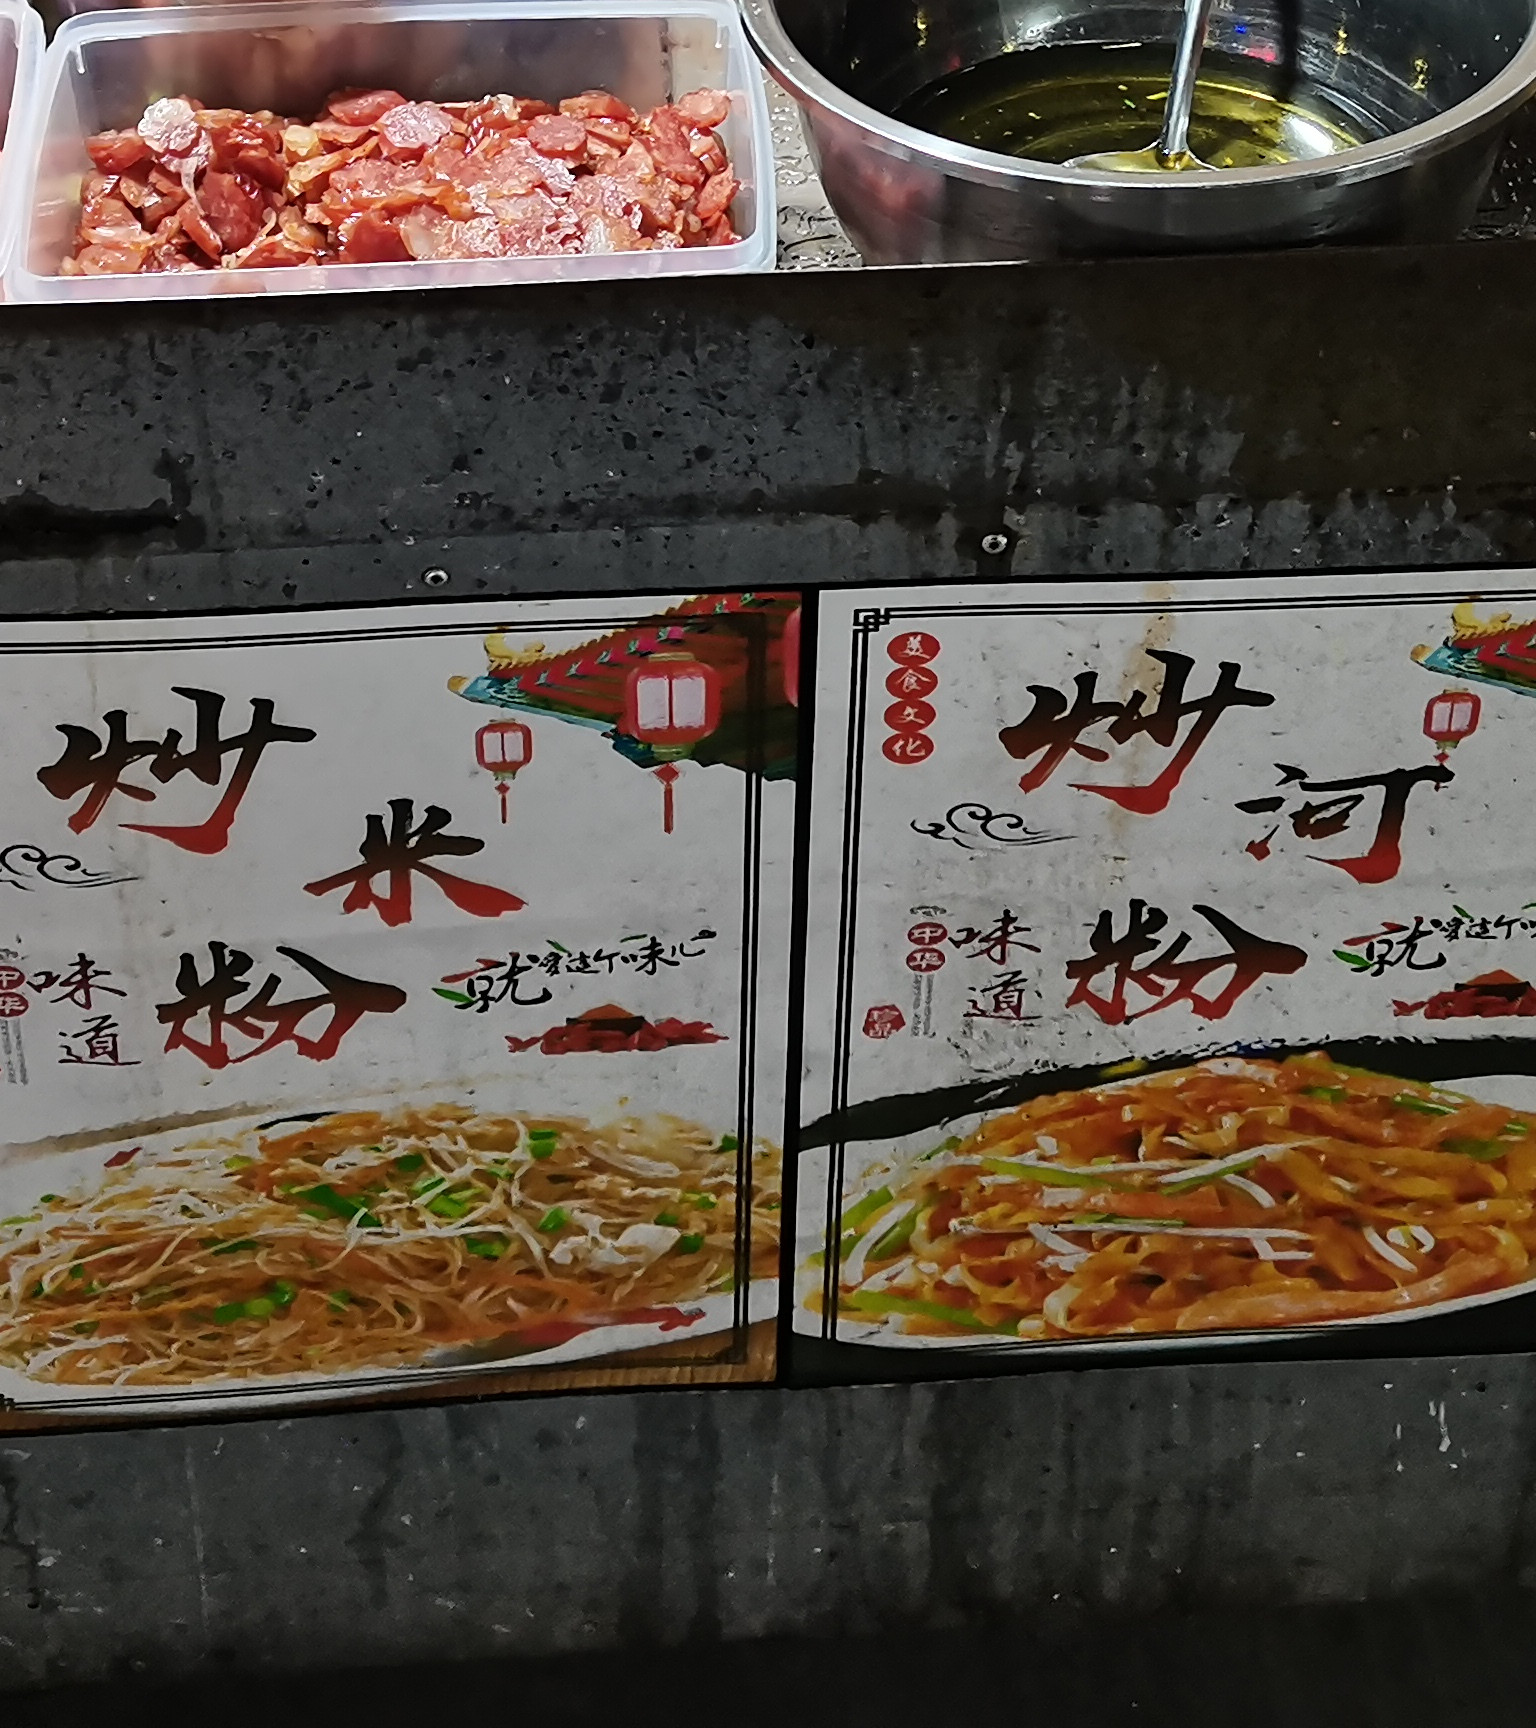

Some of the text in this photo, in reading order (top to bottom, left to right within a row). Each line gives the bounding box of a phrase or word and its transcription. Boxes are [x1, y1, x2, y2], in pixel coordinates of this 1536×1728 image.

[37, 686, 318, 854] 炒
[888, 630, 936, 760] 美食文化
[999, 649, 1275, 815] 炒
